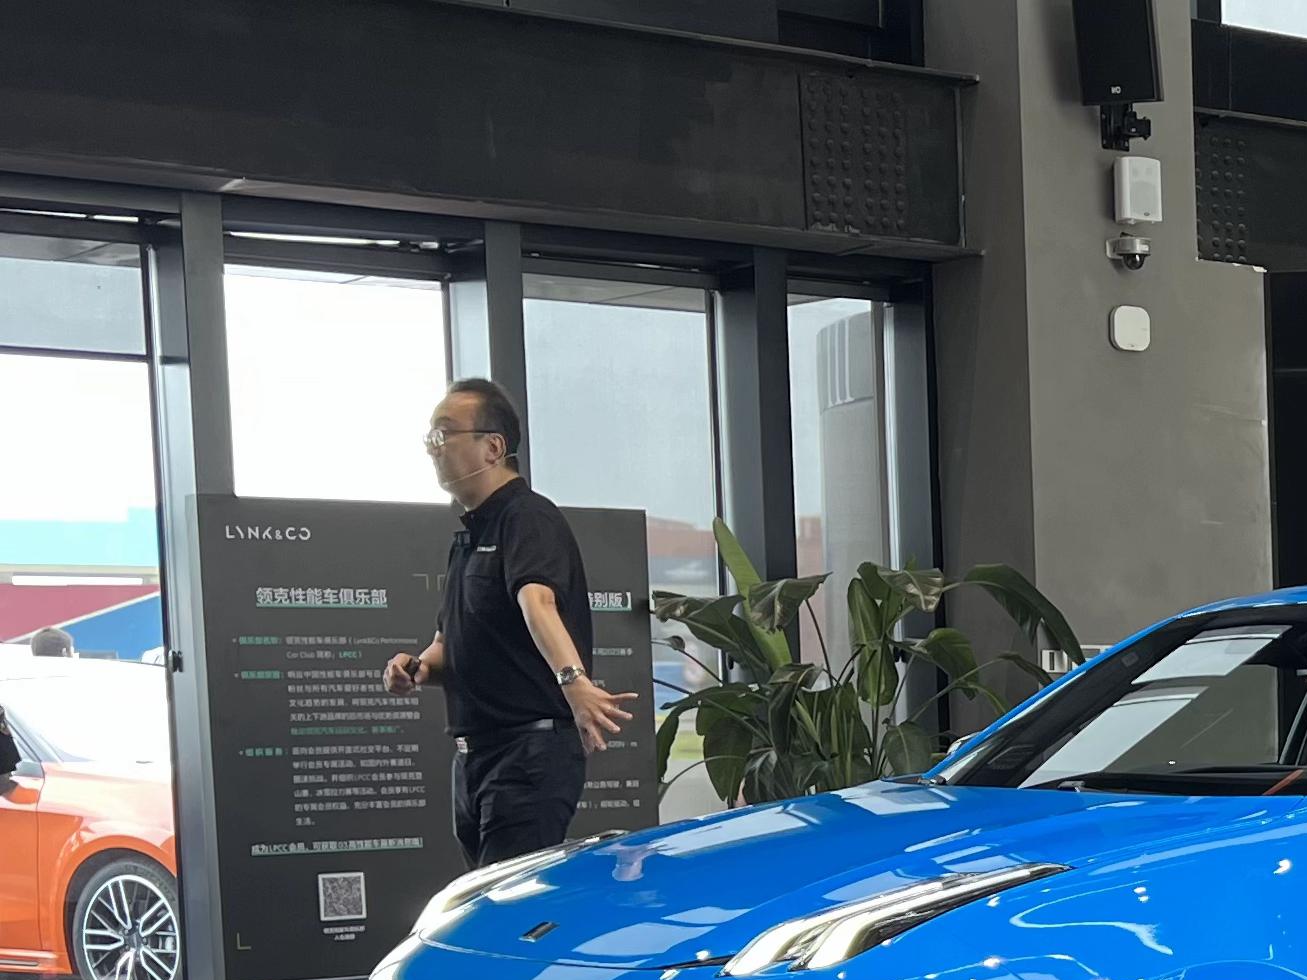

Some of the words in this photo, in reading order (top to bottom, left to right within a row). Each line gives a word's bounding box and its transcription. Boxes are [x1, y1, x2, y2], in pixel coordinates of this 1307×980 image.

[225, 524, 312, 541] LYNK&CO
[256, 587, 388, 607] 领克性能车俱乐部
